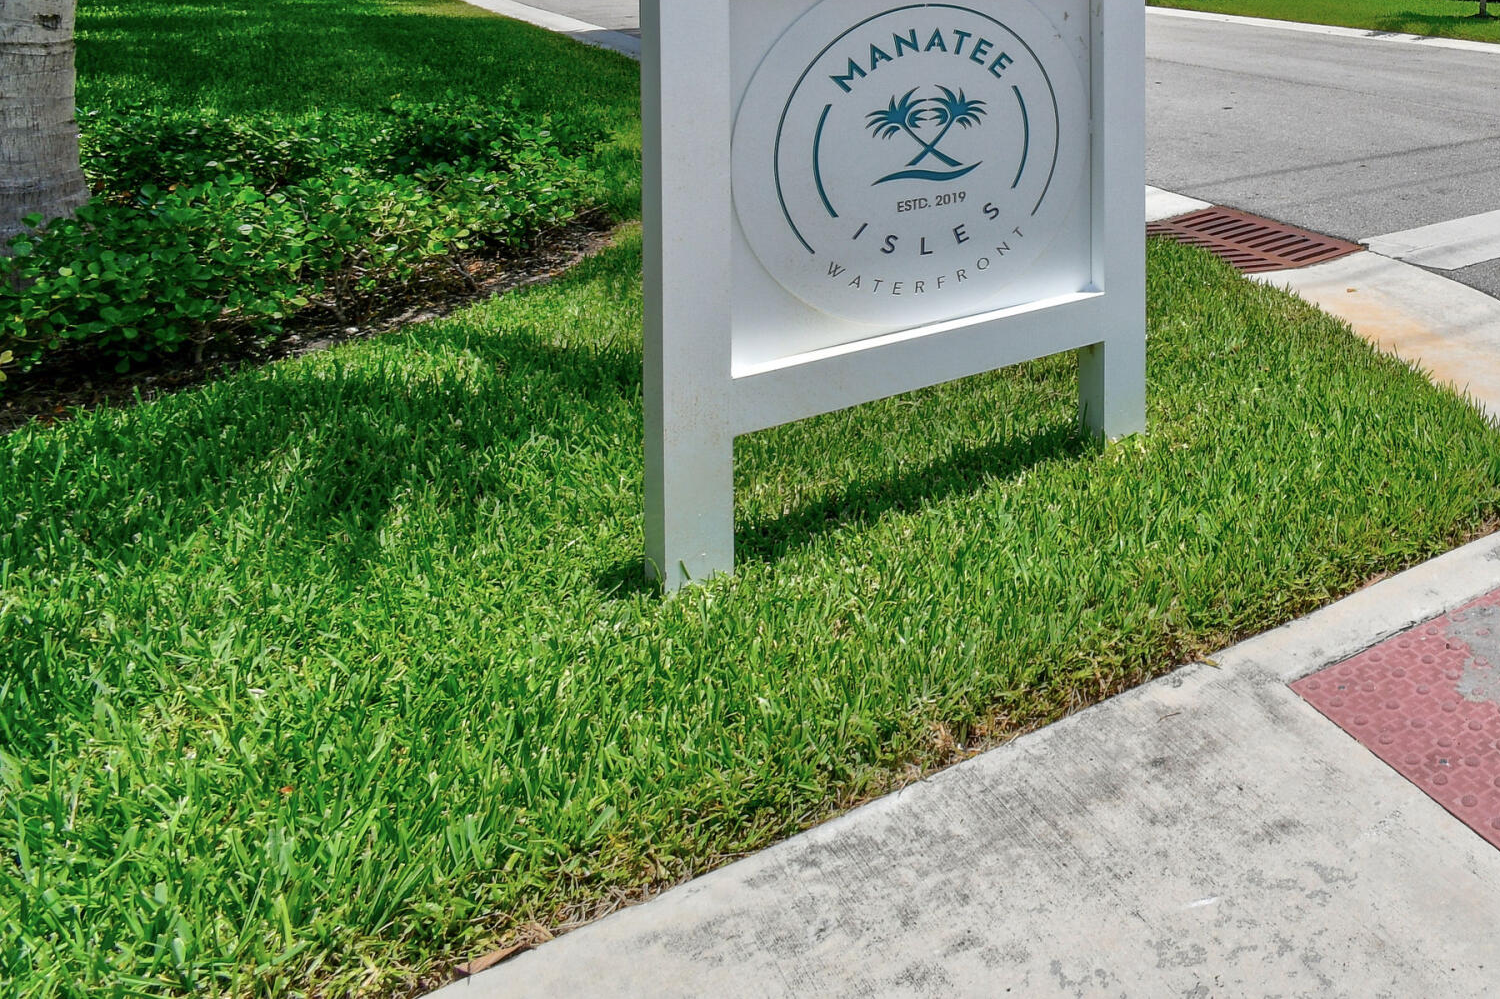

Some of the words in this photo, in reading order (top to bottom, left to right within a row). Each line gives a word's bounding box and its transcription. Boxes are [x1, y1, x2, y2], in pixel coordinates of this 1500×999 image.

[830, 28, 1014, 94] MANATEE
[852, 202, 1000, 256] ISLES
[897, 197, 932, 213] ESTD.
[935, 190, 967, 208] 2019
[827, 227, 1024, 295] WATERFRONT
